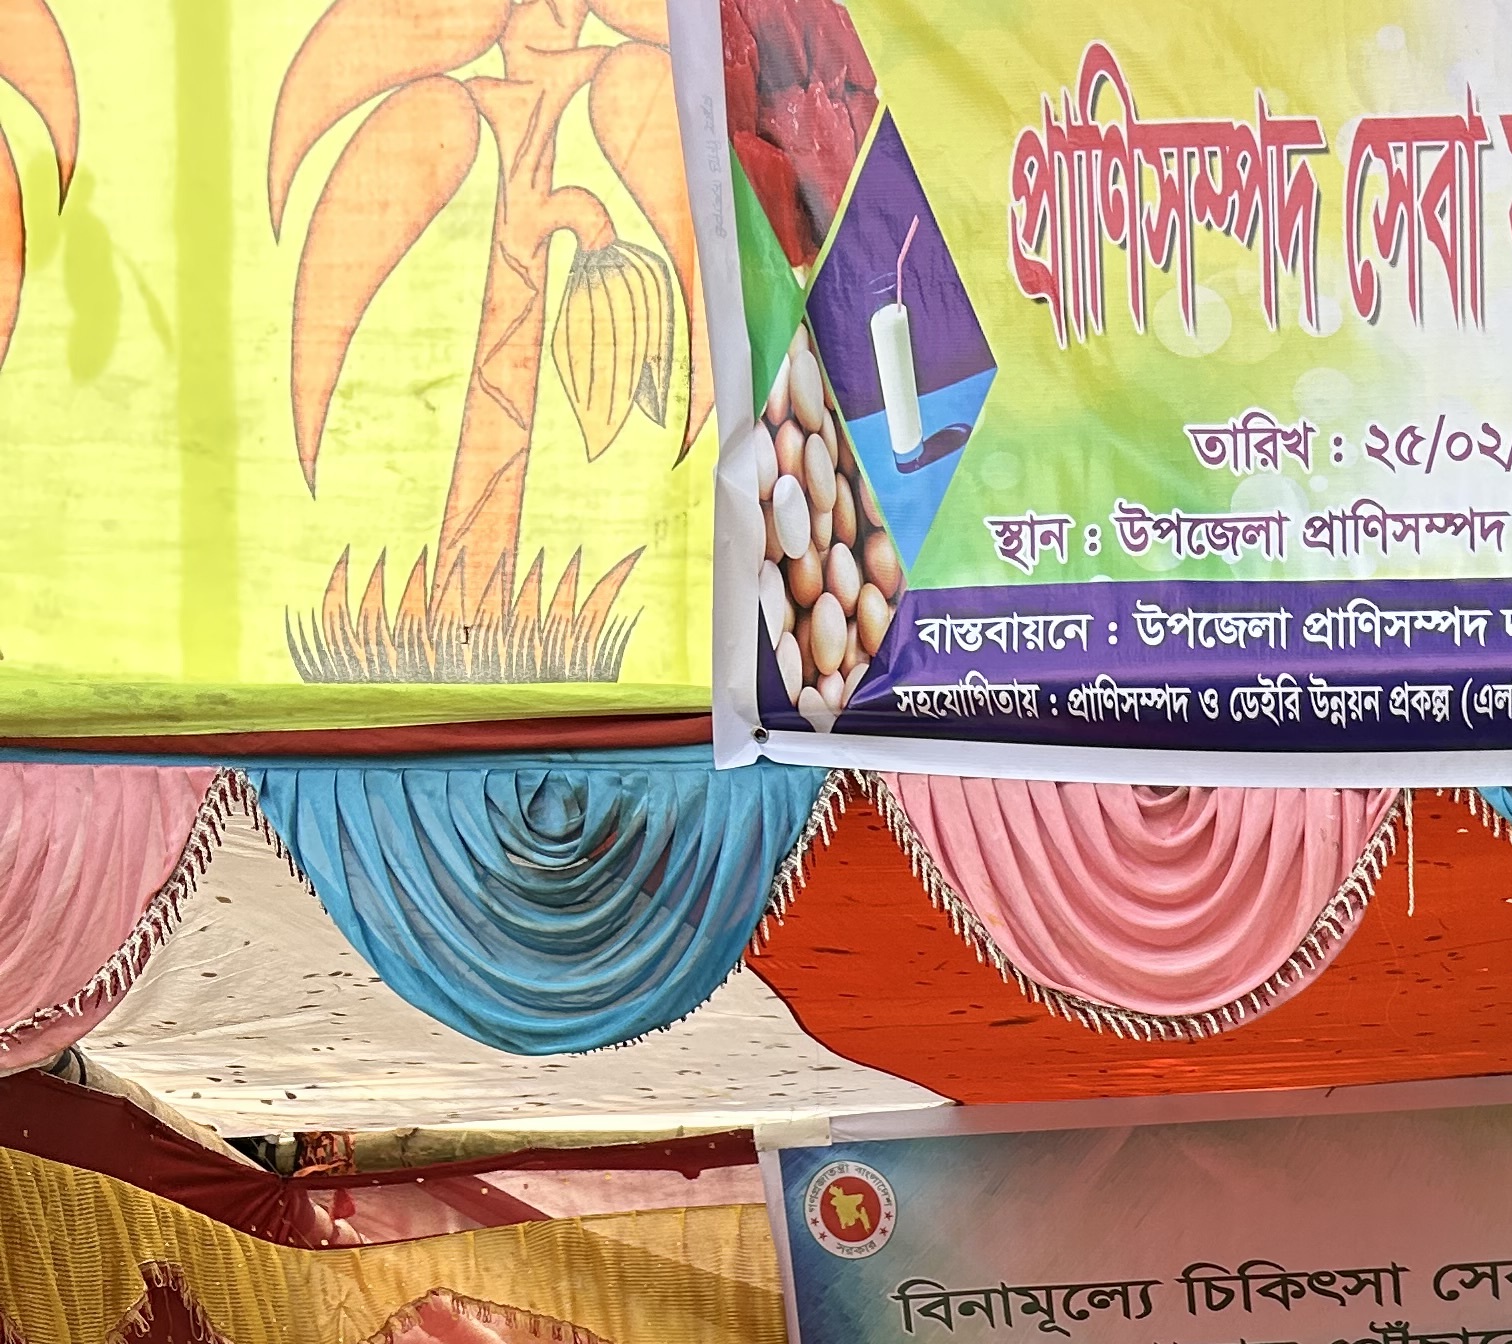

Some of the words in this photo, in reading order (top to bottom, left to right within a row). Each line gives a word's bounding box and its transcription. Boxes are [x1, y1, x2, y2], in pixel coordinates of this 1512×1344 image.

[1010, 42, 1328, 347] প্রাণিসম্পদ
[1345, 82, 1491, 329] সেবা
[1188, 411, 1315, 470] তারিখ
[988, 514, 1072, 572] স্থান
[1114, 502, 1290, 560] উপজেলা
[1302, 499, 1510, 557] প্রাণিসম্পদ
[916, 612, 1094, 654] বাস্তবায়নে
[1132, 600, 1292, 650] উপজেলা
[1302, 598, 1492, 650] প্রাণিসম্পদ
[893, 670, 1040, 720] সহযোগিতায়
[1068, 674, 1192, 722] প্রাণিসম্পদ
[1198, 691, 1219, 720] ও
[1230, 673, 1302, 726] ডেইরি
[1308, 673, 1383, 728] উন্নয়ন
[1389, 681, 1453, 722] প্রকল্প
[892, 1278, 1162, 1337] বিনামূল্যে
[1176, 1260, 1410, 1314] চিকিৎসা
